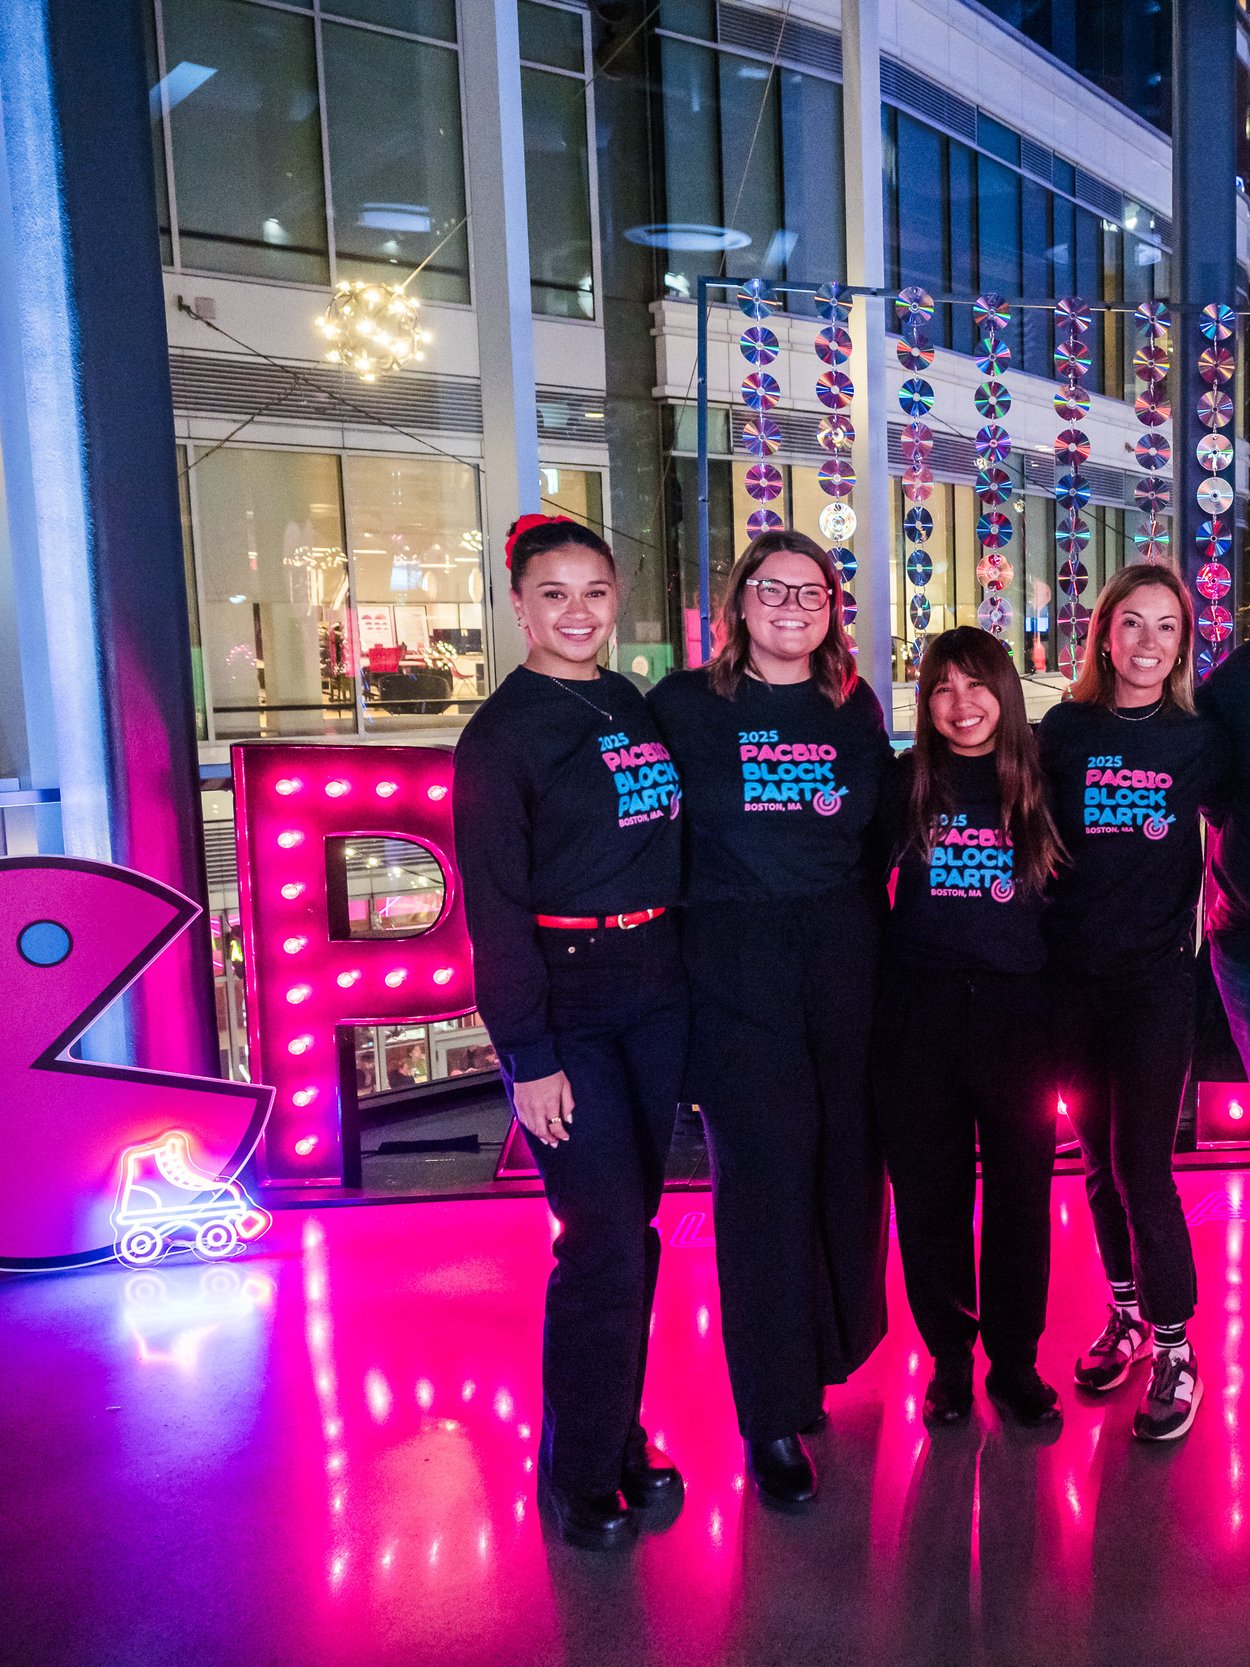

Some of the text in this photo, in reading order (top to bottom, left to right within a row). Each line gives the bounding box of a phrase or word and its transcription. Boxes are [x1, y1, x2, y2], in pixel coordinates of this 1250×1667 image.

[598, 732, 630, 752] 2025
[738, 730, 779, 743] 2025
[602, 742, 671, 772] PACBIO
[740, 743, 837, 762] PACBIO
[1087, 755, 1122, 768] 2025
[614, 762, 679, 794] BLOCK
[742, 762, 835, 780] BLOCK
[1086, 769, 1173, 789] PACBIO
[618, 783, 680, 817] PARTY
[744, 781, 836, 803] PARTY
[1084, 787, 1166, 806] BLOCK
[744, 802, 802, 812] BOSTON, MA
[930, 814, 967, 827] 025
[1084, 807, 1166, 828] PARTY
[1121, 826, 1134, 834] MA
[930, 847, 1014, 868] BLOCK
[930, 868, 1012, 890] PARTY
[931, 888, 982, 898] BOSTON, MA
